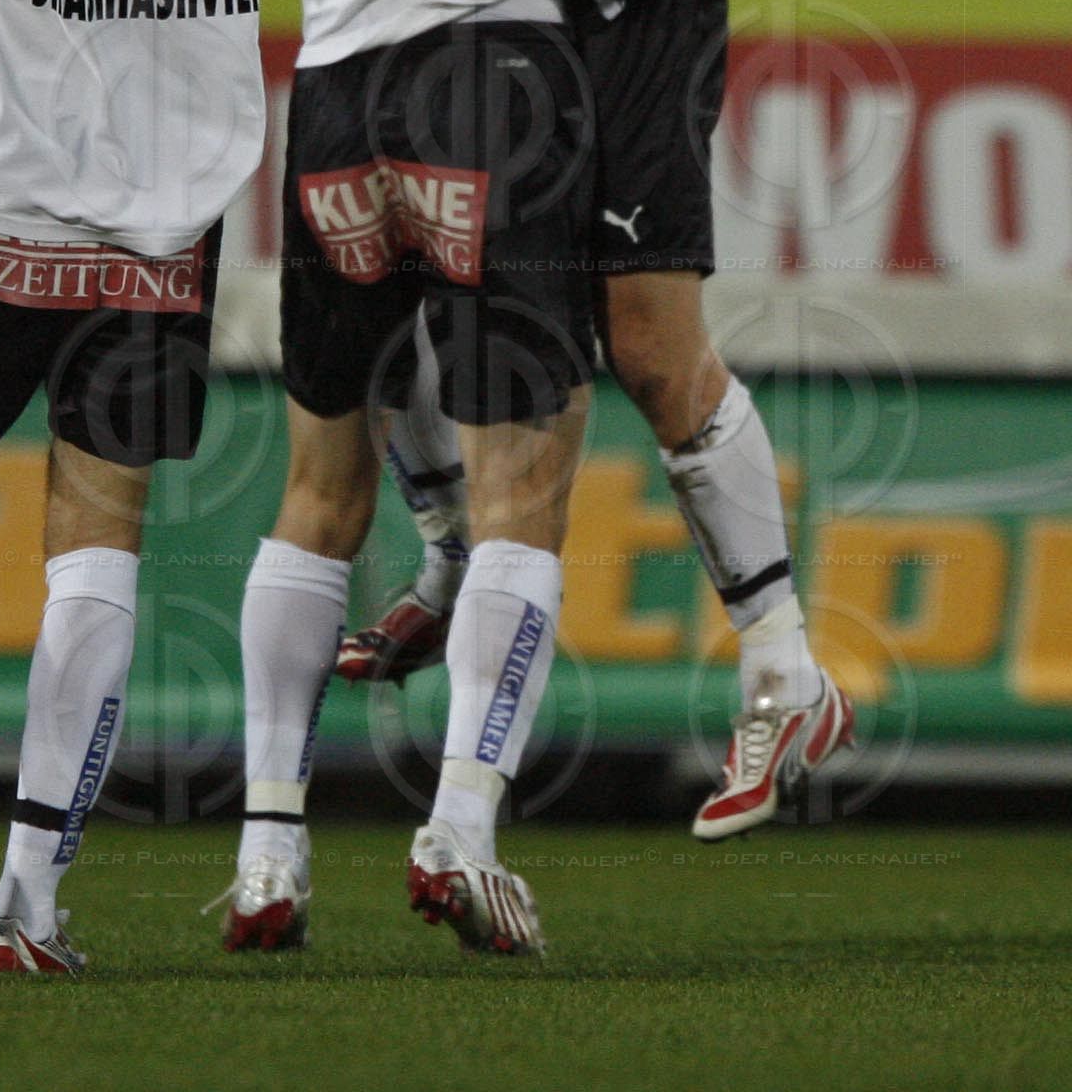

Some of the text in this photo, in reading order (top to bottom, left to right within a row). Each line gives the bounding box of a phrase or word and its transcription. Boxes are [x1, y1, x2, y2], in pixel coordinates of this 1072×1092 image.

[307, 166, 475, 233] KLENE
[478, 607, 546, 760] PUNTIGAMER
[58, 703, 118, 859] PUNTIGAMER
